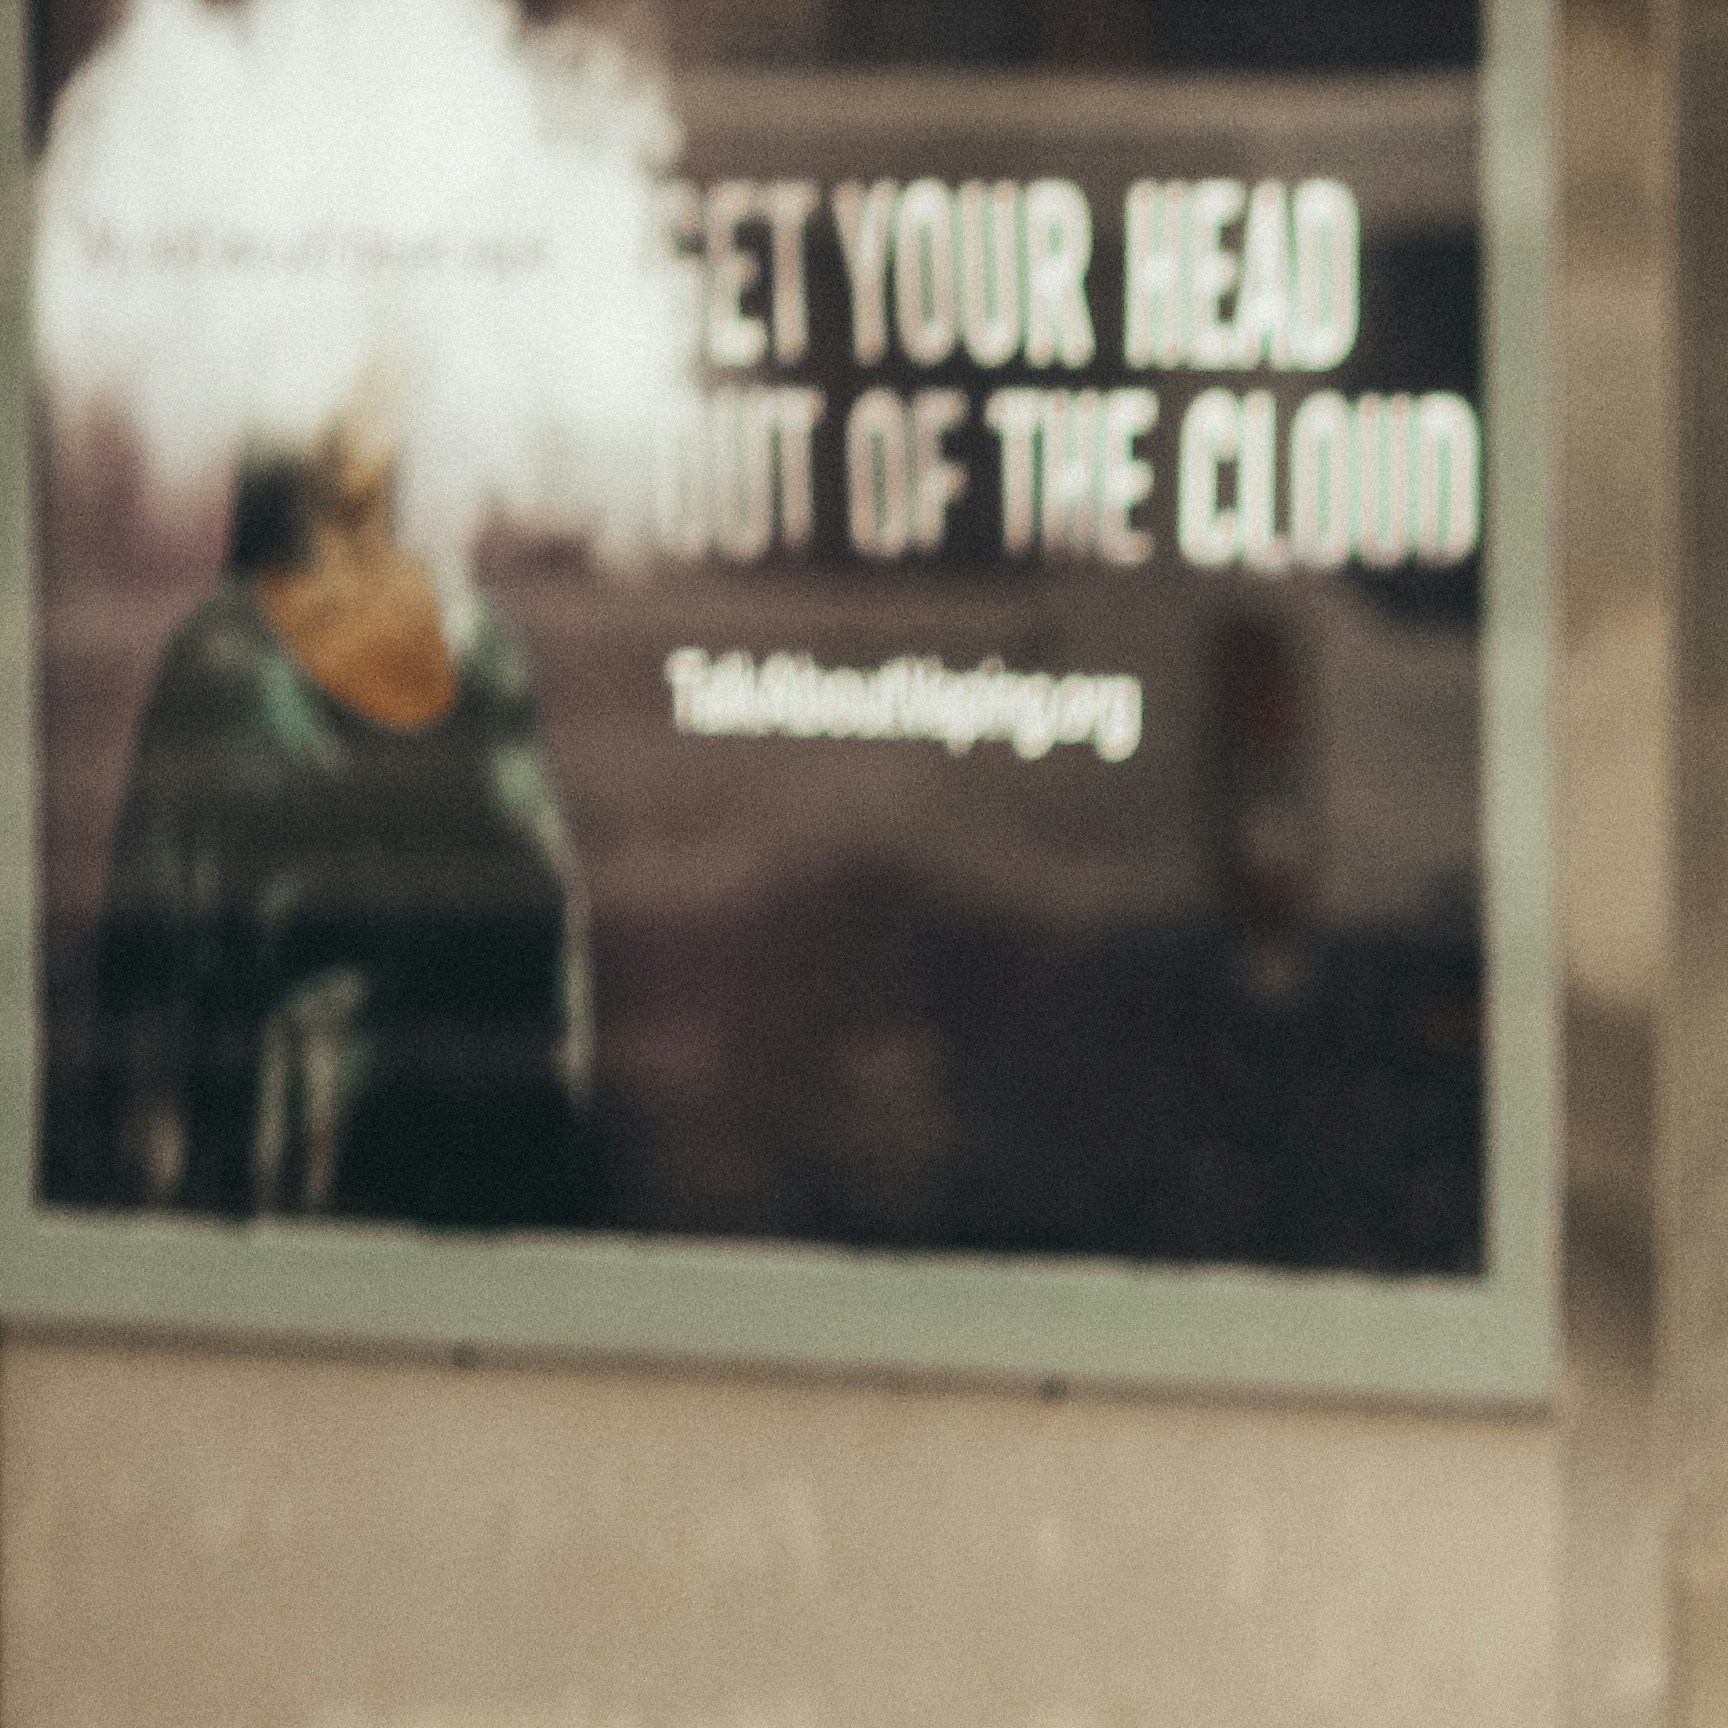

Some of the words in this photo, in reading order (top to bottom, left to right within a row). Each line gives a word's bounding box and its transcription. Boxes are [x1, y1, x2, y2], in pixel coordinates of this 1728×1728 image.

[834, 178, 1095, 367] YOUR
[1125, 177, 1360, 370] HEAD
[847, 388, 968, 556] OF
[986, 389, 1157, 565] THE
[1177, 389, 1480, 571] CLOUD
